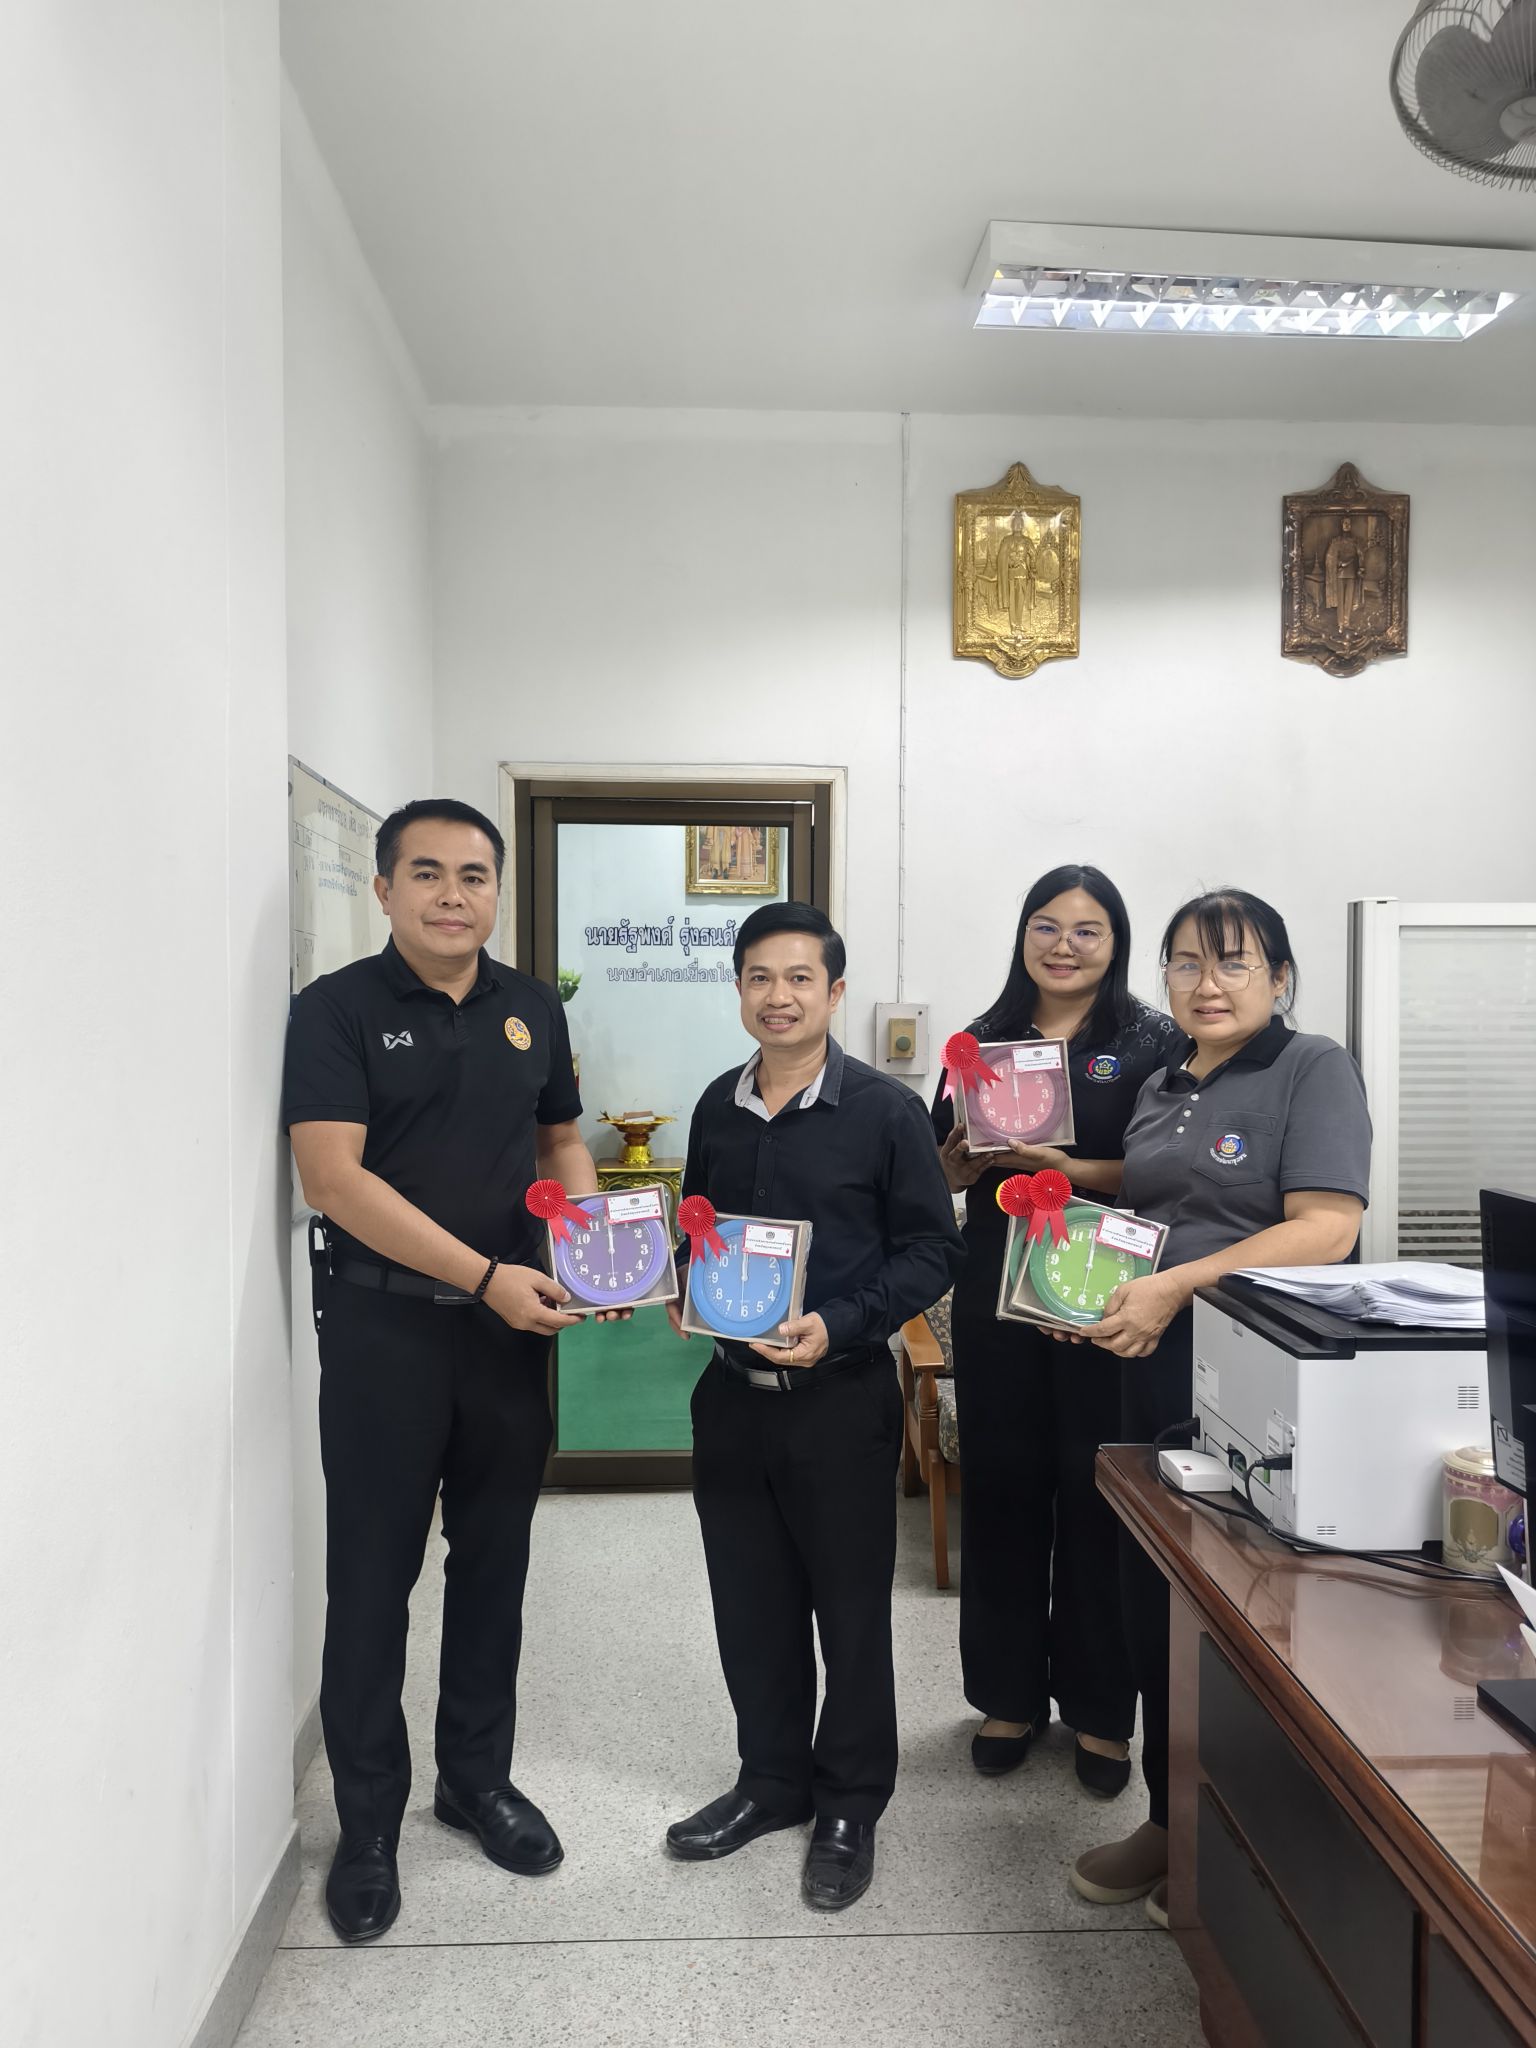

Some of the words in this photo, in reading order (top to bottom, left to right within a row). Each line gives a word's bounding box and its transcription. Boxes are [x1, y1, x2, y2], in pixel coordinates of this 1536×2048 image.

[585, 916, 675, 953] นายรัฐพงศ์
[1035, 1074, 1043, 1084] 2
[982, 1094, 990, 1104] 9
[1041, 1088, 1049, 1099] 3
[987, 1107, 996, 1118] 8
[1037, 1103, 1045, 1113] 4
[999, 1117, 1007, 1127] 7
[1014, 1119, 1022, 1129] 6
[1028, 1114, 1036, 1125] 5
[576, 1233, 591, 1245] 10
[633, 1227, 642, 1239] 2
[1071, 1229, 1084, 1242] 11
[575, 1248, 583, 1260] 9
[640, 1243, 649, 1255] 3
[728, 1243, 738, 1255] 11
[769, 1256, 777, 1269] 2
[1050, 1253, 1060, 1265] 9
[1116, 1251, 1126, 1263] 2
[579, 1264, 589, 1275] 8
[635, 1259, 644, 1271] 4
[592, 1274, 601, 1286] 7
[625, 1272, 634, 1284] 5
[711, 1271, 719, 1284] 9
[773, 1273, 781, 1285] 3
[1050, 1270, 1061, 1283] 8
[1118, 1269, 1128, 1282] 3
[608, 1277, 618, 1288] 6
[716, 1288, 723, 1300] 8
[767, 1289, 776, 1302] 4
[1062, 1285, 1072, 1297] 7
[725, 1299, 733, 1312] 7
[1077, 1294, 1087, 1306] 6
[1095, 1294, 1104, 1306] 5
[741, 1305, 749, 1317] 6
[756, 1301, 764, 1313] 5
